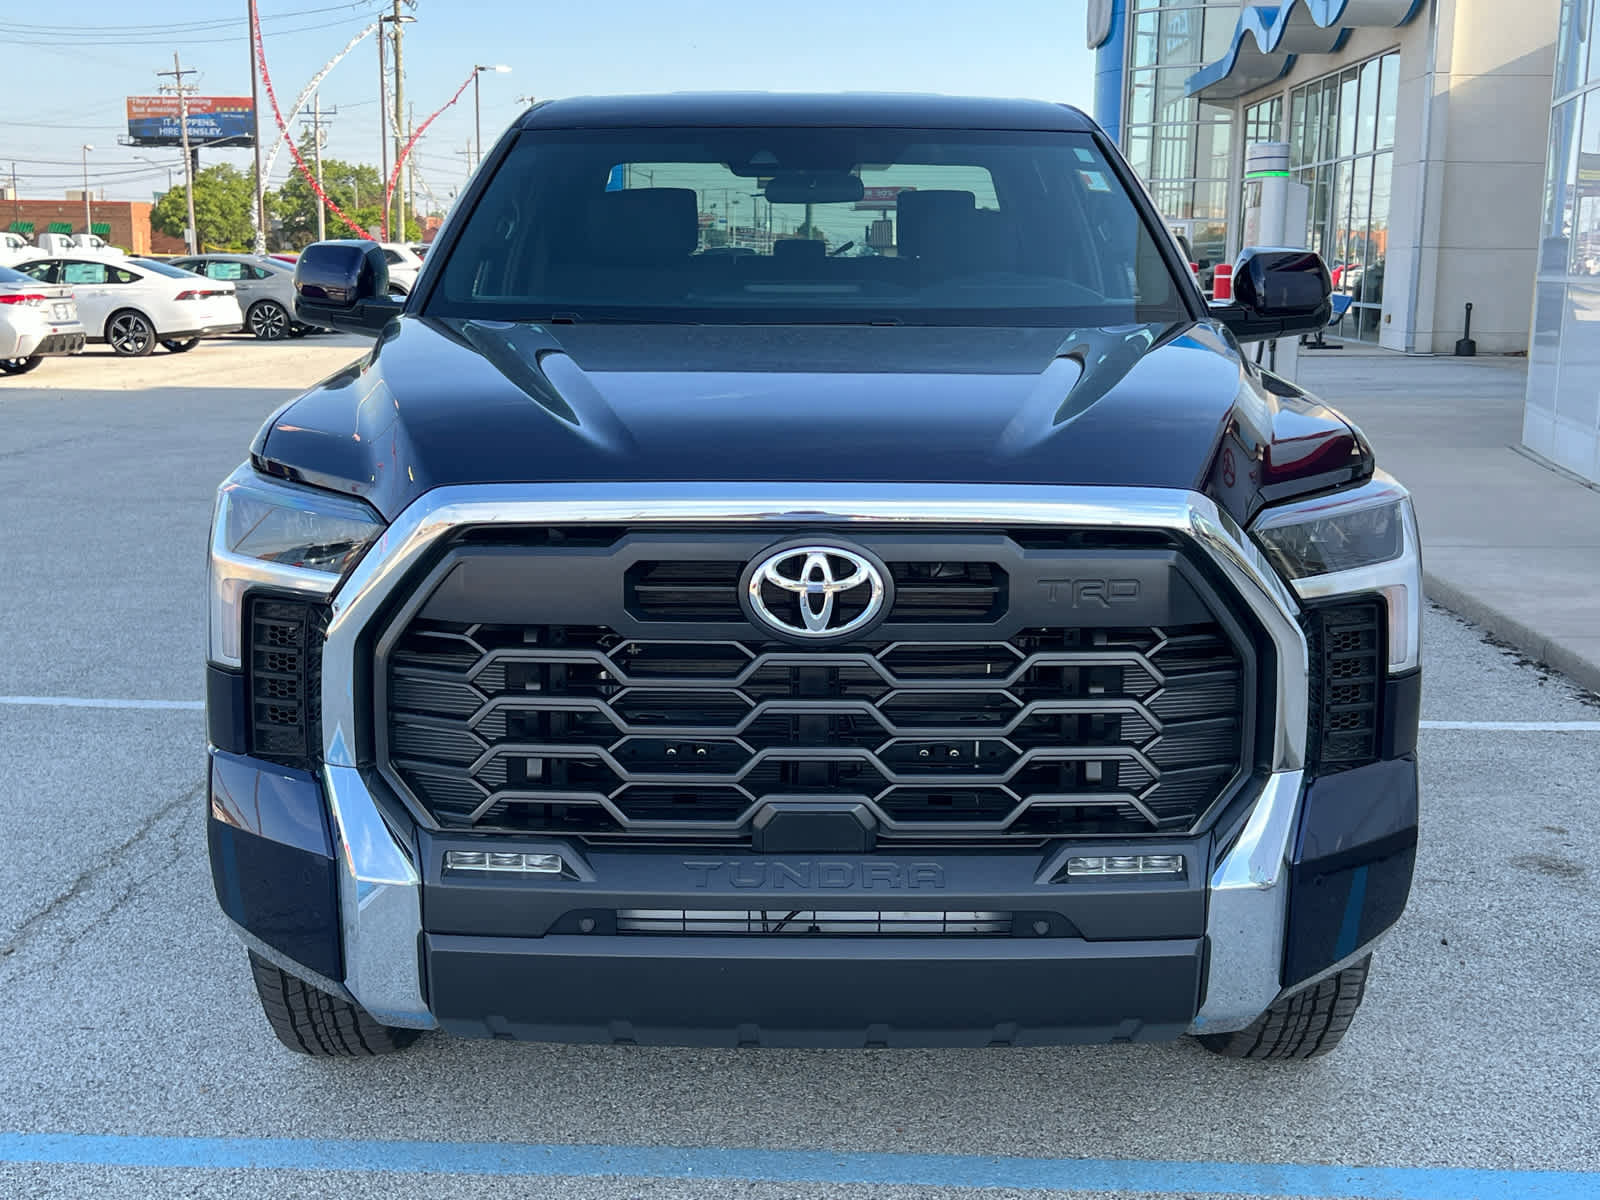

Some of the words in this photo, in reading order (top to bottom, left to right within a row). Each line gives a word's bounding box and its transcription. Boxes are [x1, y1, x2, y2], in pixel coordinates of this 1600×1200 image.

[159, 127, 179, 136] HIRE
[183, 127, 223, 137] ENSLEY.
[163, 118, 172, 126] IT
[173, 118, 218, 127] HPPENS.
[1036, 577, 1143, 609] TRD
[682, 860, 946, 889] TUNDRA
